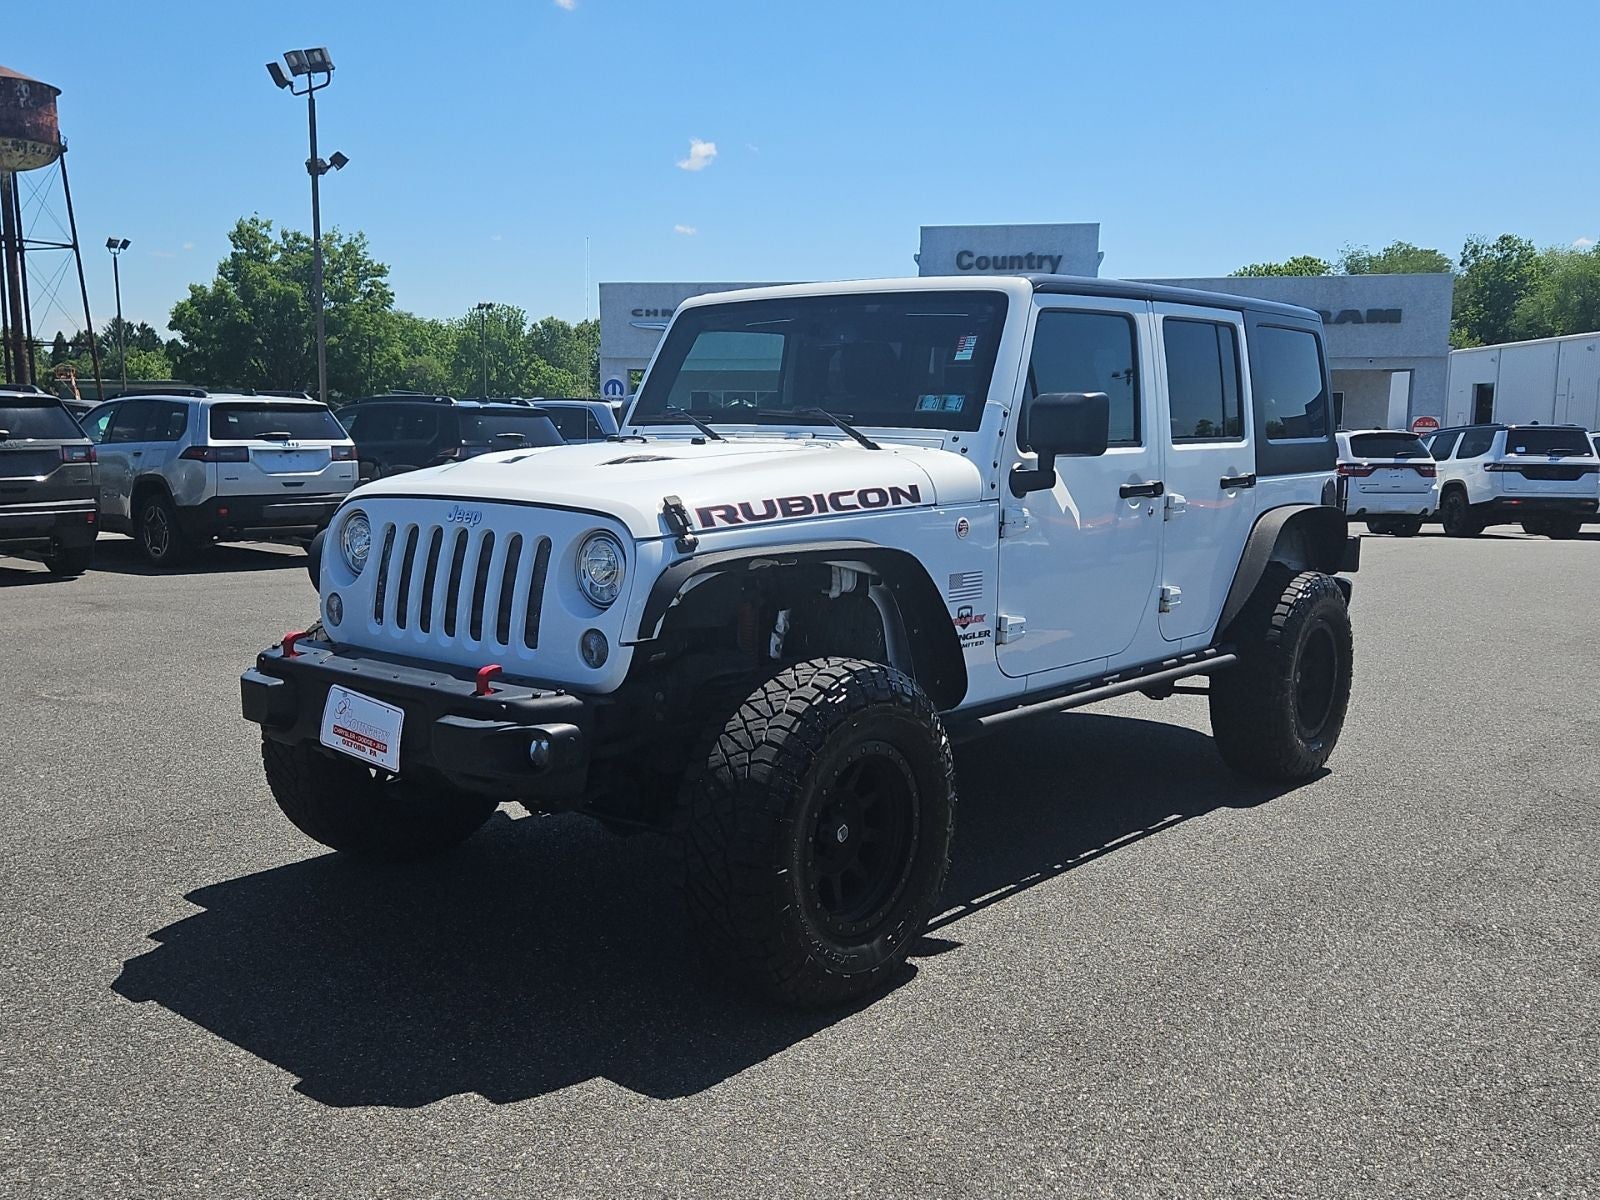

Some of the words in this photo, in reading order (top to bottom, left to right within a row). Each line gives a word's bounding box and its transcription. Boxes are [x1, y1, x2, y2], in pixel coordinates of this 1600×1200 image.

[956, 250, 1063, 274] Country
[631, 308, 674, 317] CHR
[695, 484, 922, 529] RUBICON
[446, 504, 483, 528] Jeep
[958, 629, 991, 641] NGLER
[961, 640, 984, 649] MITED
[369, 748, 378, 758] PA
